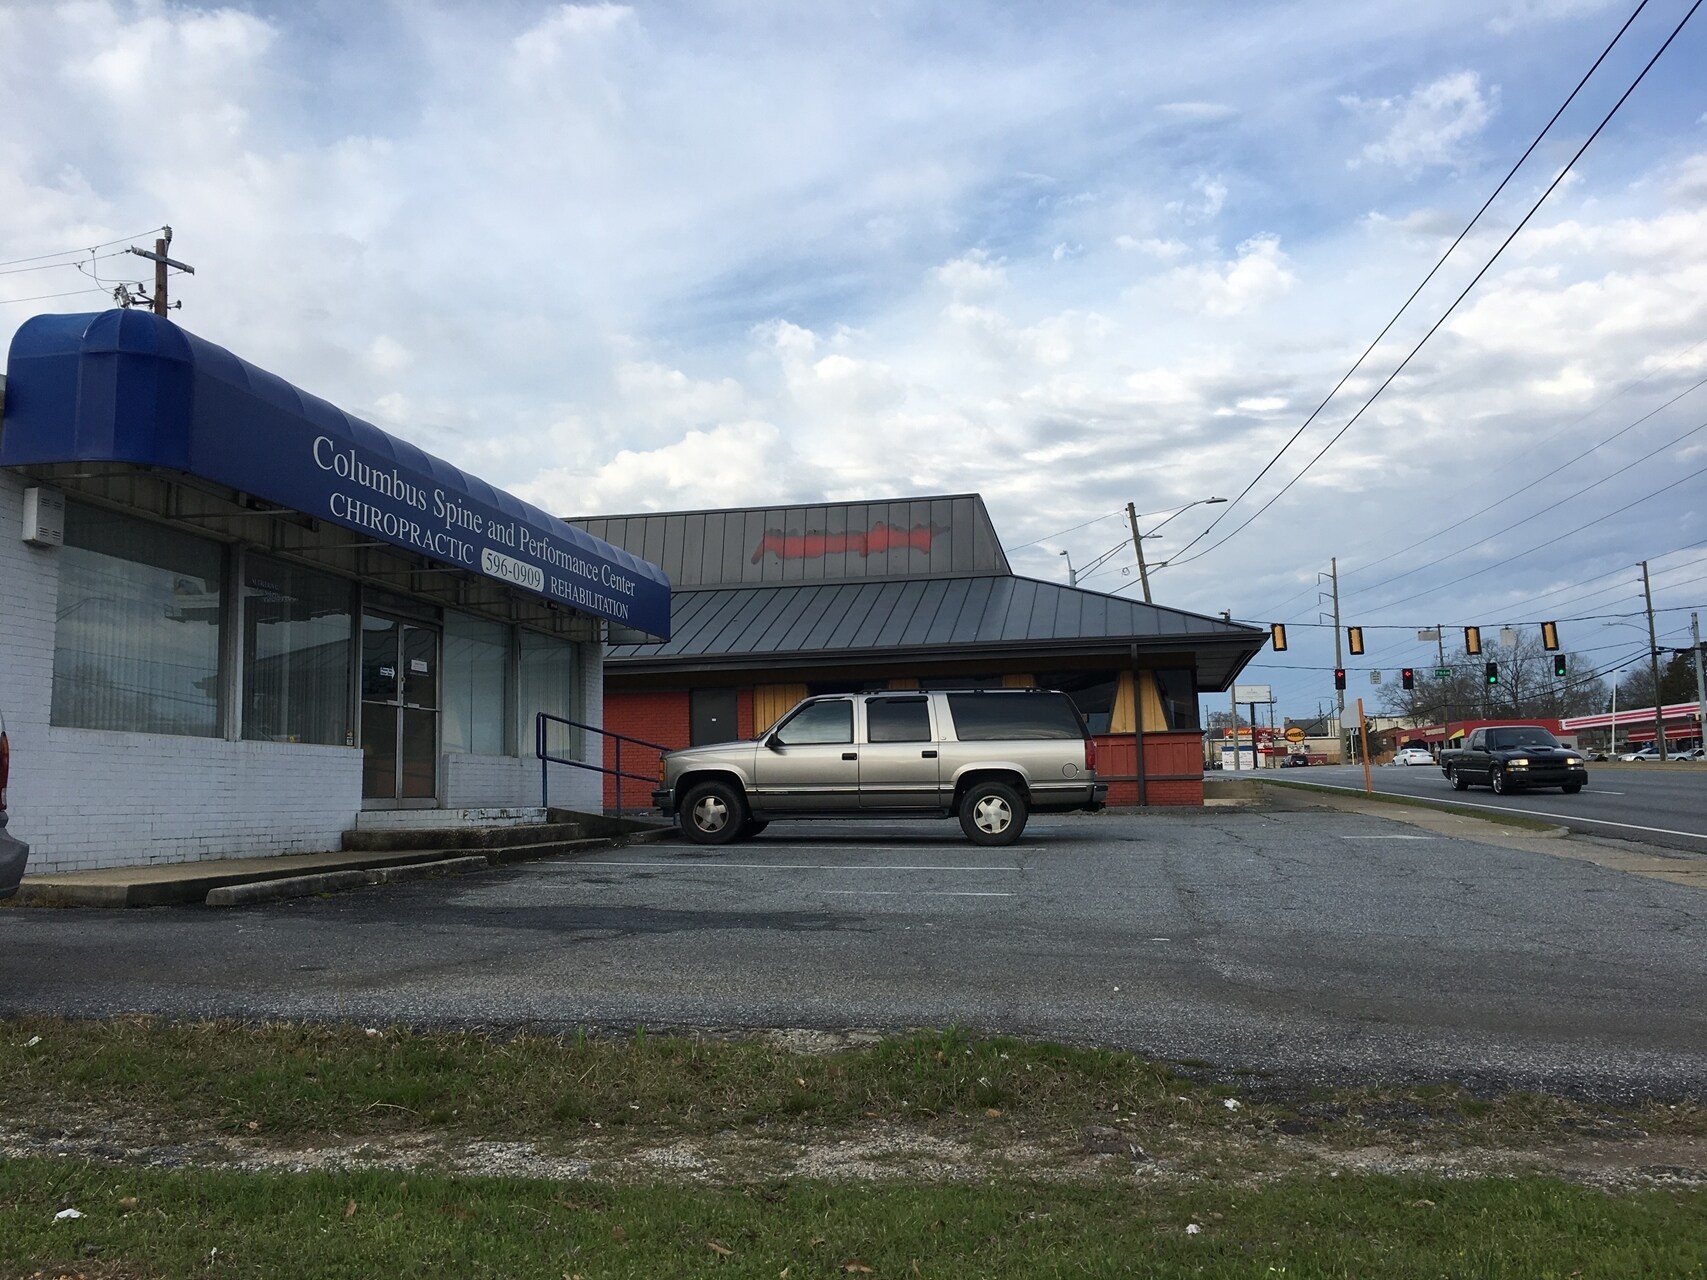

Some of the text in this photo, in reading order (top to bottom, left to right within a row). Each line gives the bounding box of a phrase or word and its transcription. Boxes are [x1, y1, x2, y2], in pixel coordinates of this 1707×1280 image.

[313, 436, 636, 597] Columbus Spine and Performance Center
[329, 493, 474, 565] CHIROPRACTIC
[485, 552, 541, 588] 596-0909
[550, 576, 629, 620] REHABILITATION
